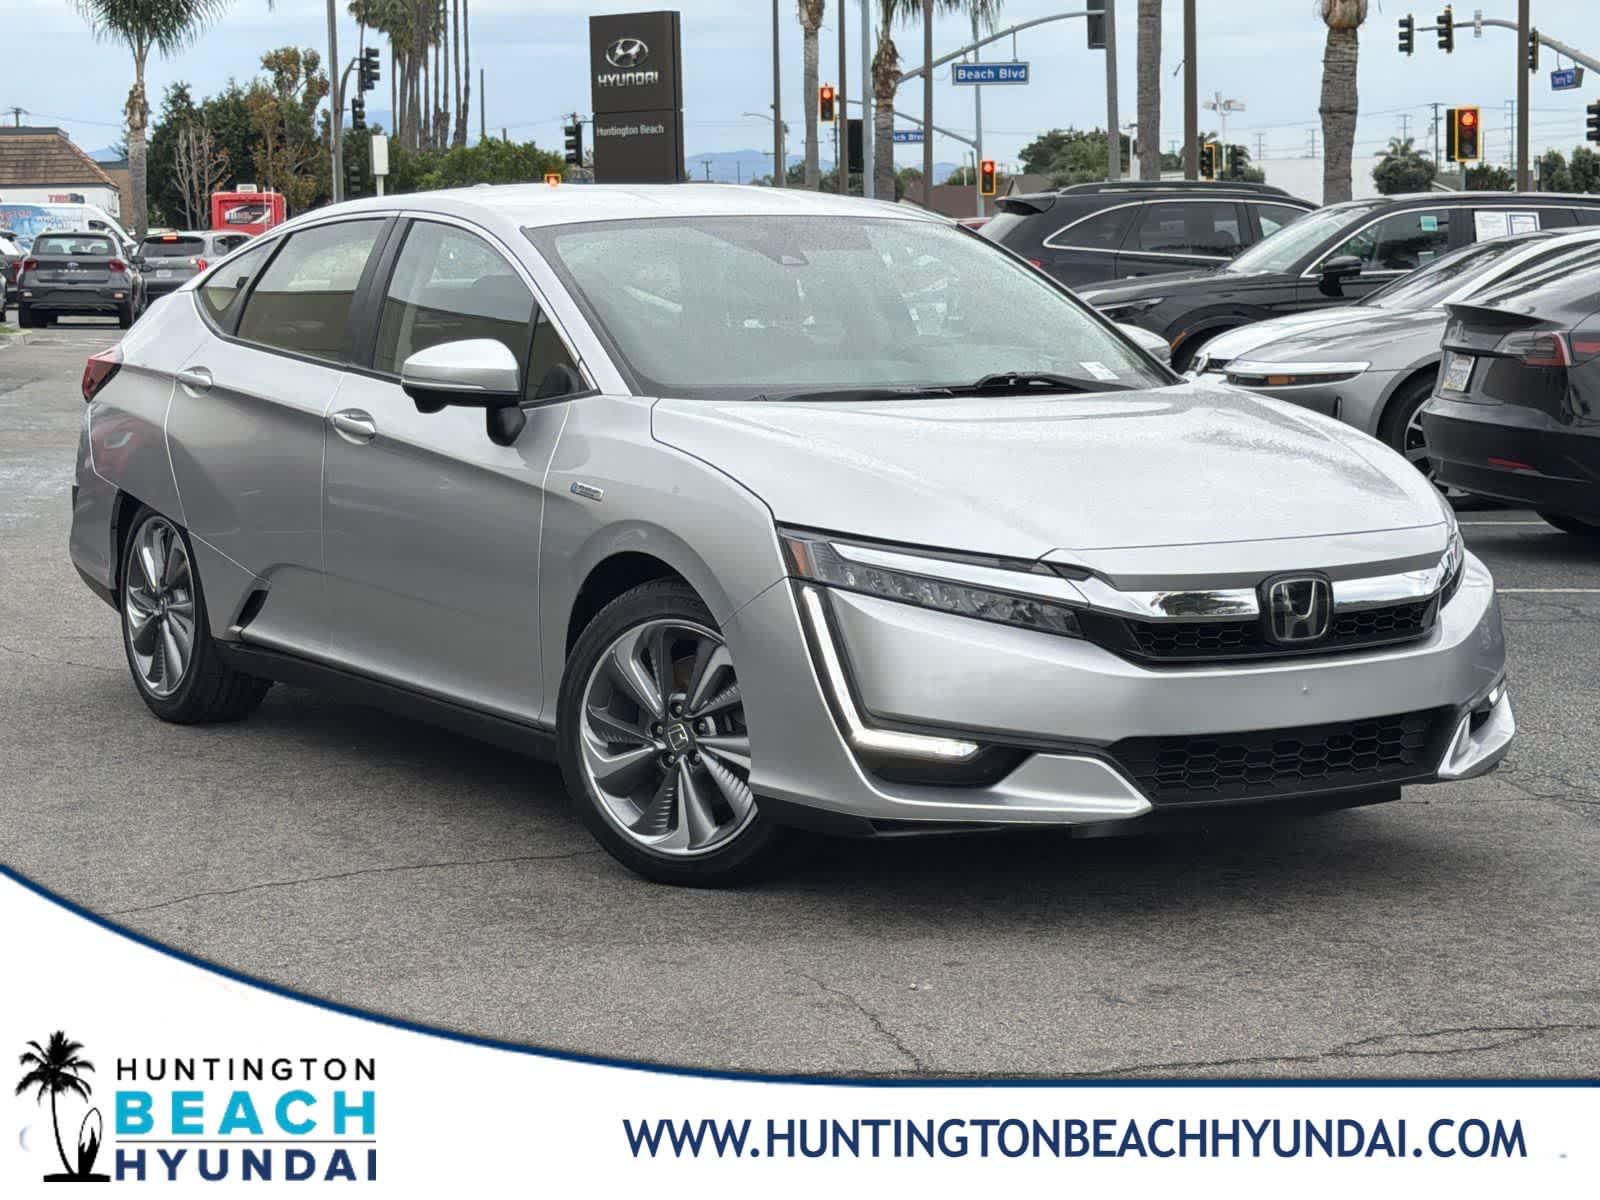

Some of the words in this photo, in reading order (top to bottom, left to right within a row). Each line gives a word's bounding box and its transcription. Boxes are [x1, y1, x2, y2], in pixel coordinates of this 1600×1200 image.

[598, 71, 659, 88] HYUNDAI
[957, 68, 994, 80] Beach
[999, 67, 1025, 79] Blvd
[596, 126, 639, 137] Huntington
[639, 124, 664, 134] Beach
